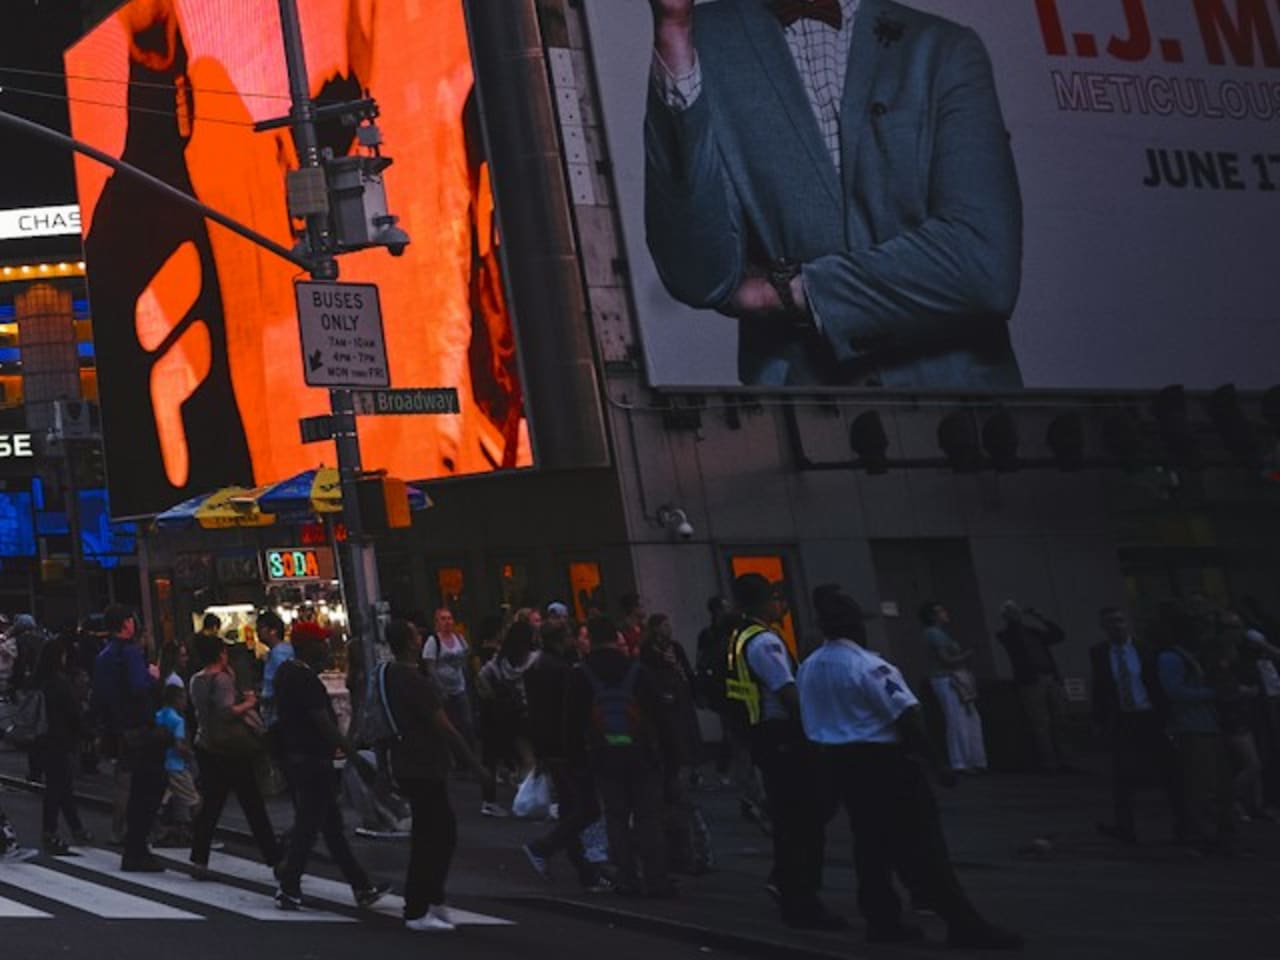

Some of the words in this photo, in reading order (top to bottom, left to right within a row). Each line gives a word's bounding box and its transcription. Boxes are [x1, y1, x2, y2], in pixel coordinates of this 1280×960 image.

[1143, 148, 1246, 191] JUNE
[313, 291, 365, 311] BUSES
[321, 313, 360, 331] ONLY
[377, 391, 455, 412] Broadway
[269, 551, 320, 577] SODA
